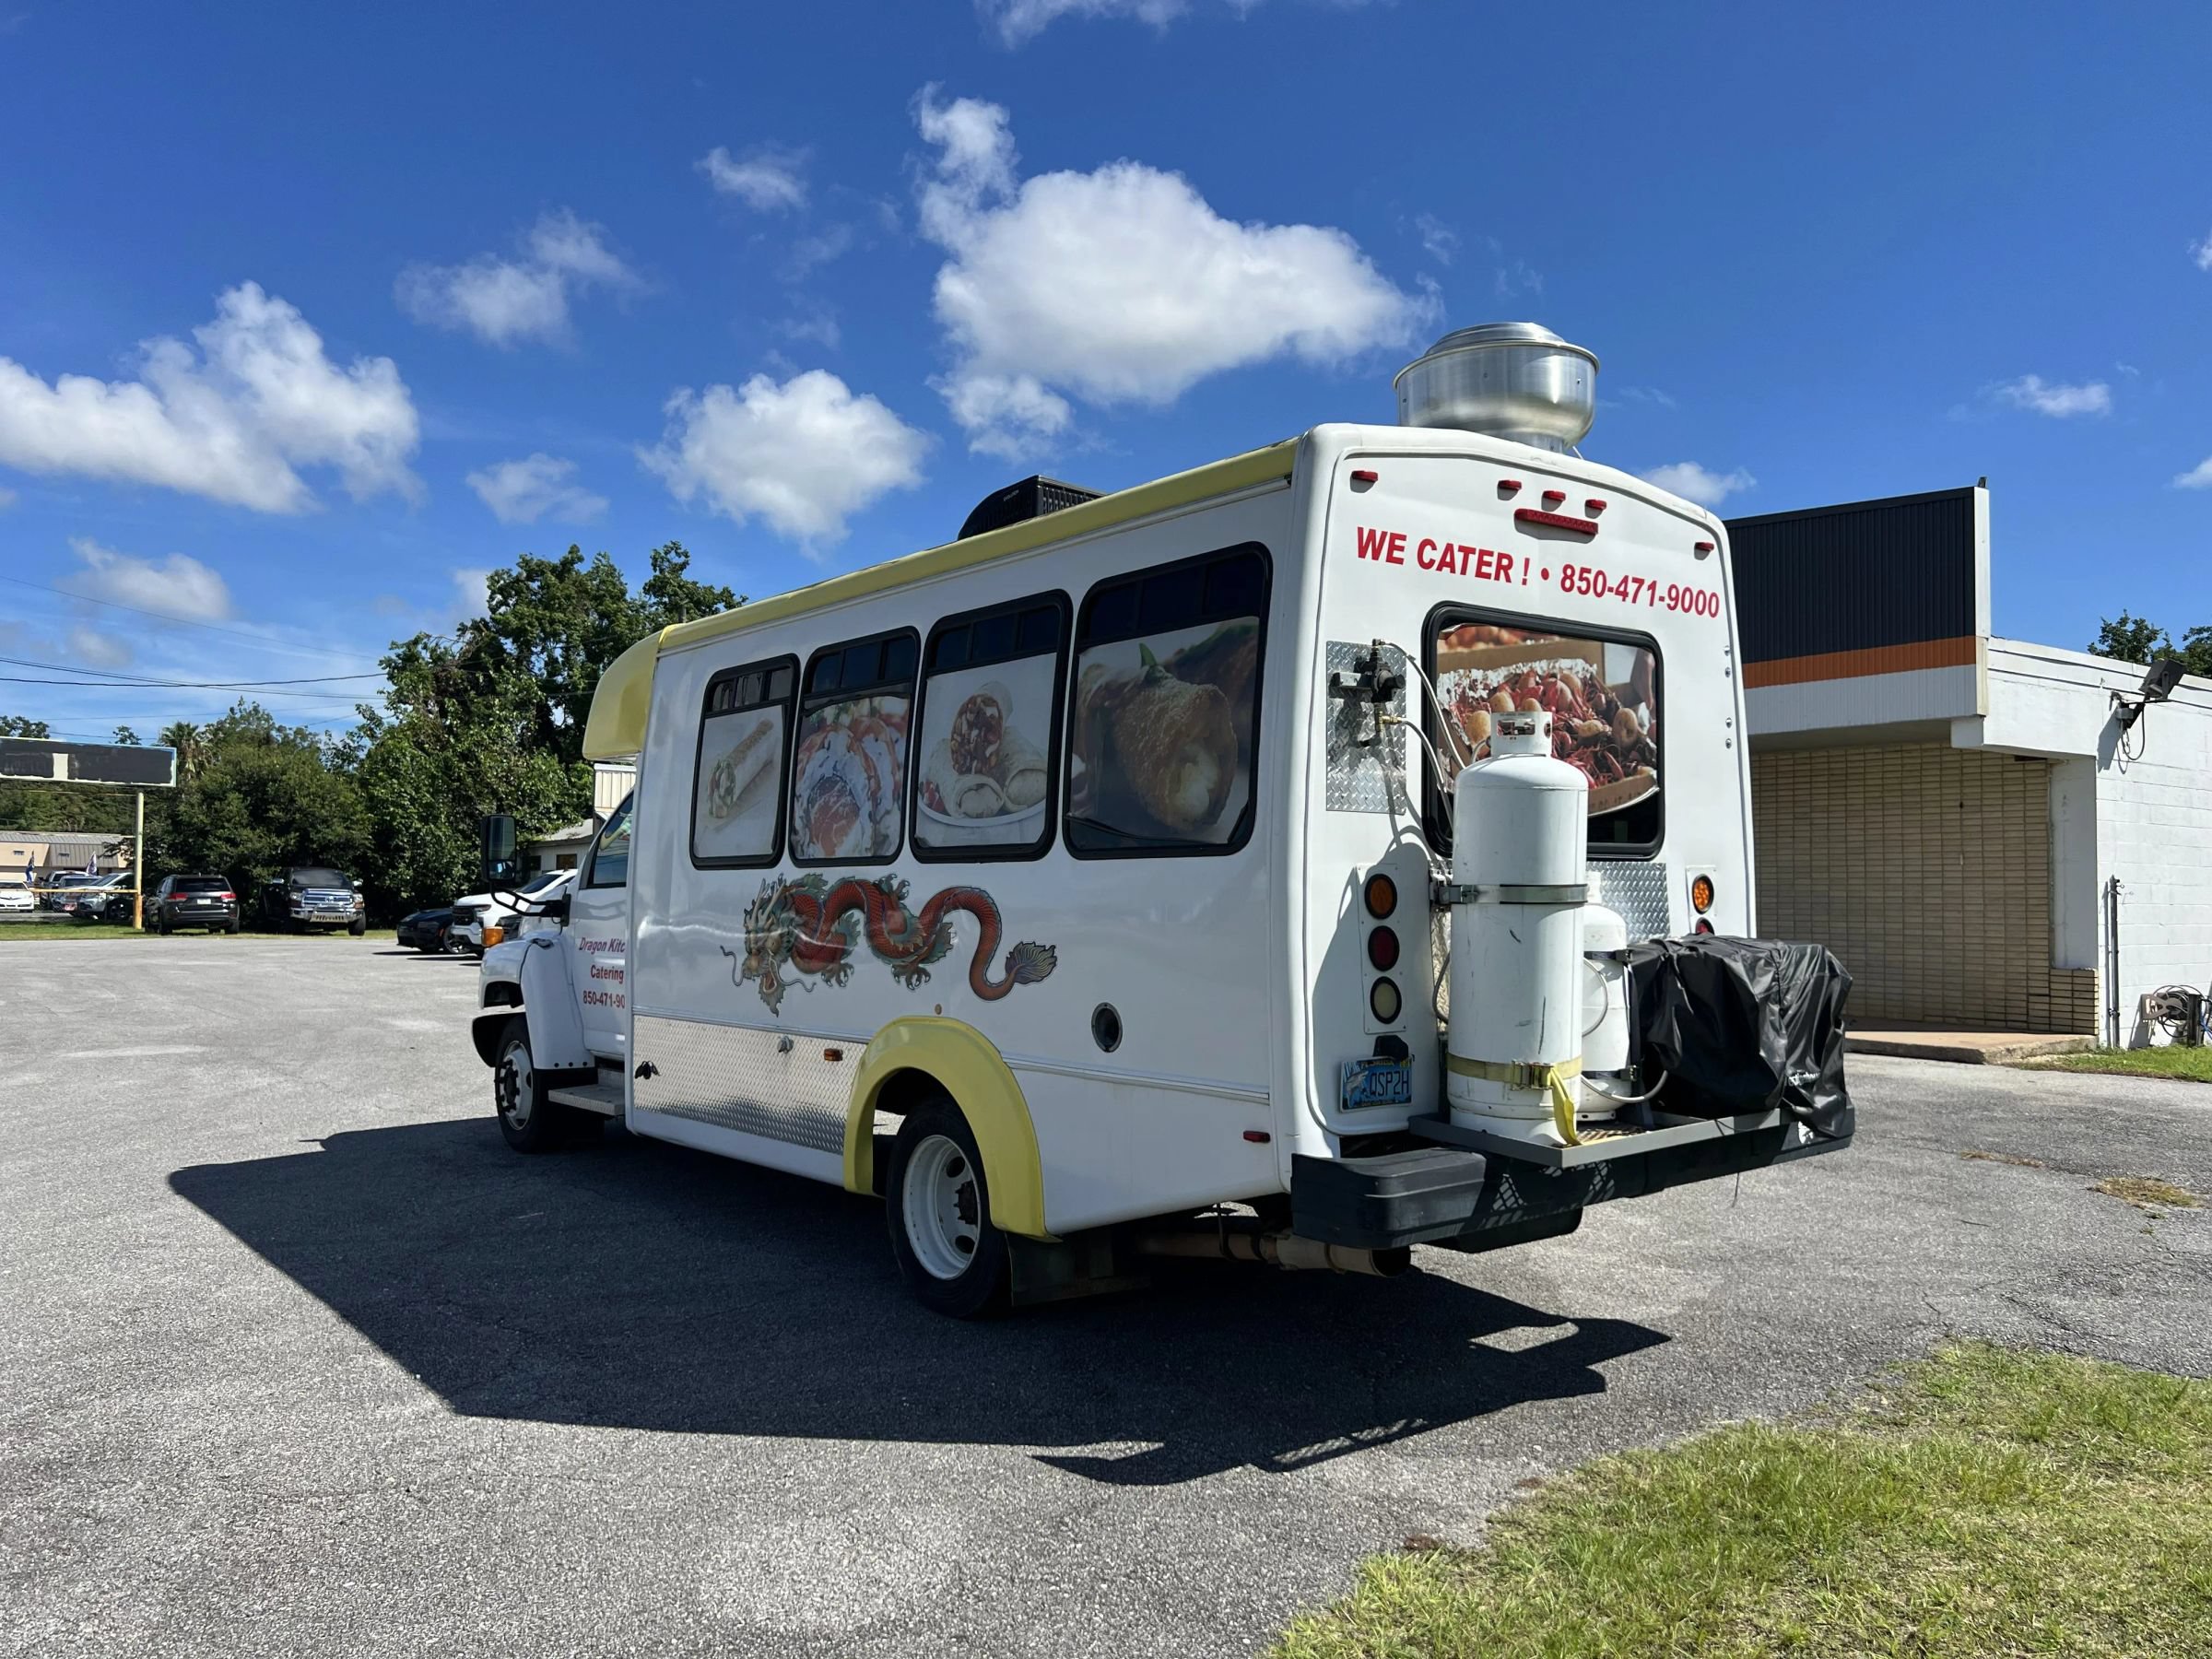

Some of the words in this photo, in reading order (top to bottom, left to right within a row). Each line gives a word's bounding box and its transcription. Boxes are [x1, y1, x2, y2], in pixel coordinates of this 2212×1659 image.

[1357, 526, 1407, 565] WE
[1417, 538, 1514, 582] CATER
[1521, 557, 1531, 586] !
[1560, 563, 1720, 618] 850-471-9000
[579, 936, 607, 955] Dragon
[590, 964, 624, 984] Catering
[582, 990, 626, 1009] 850-471-90
